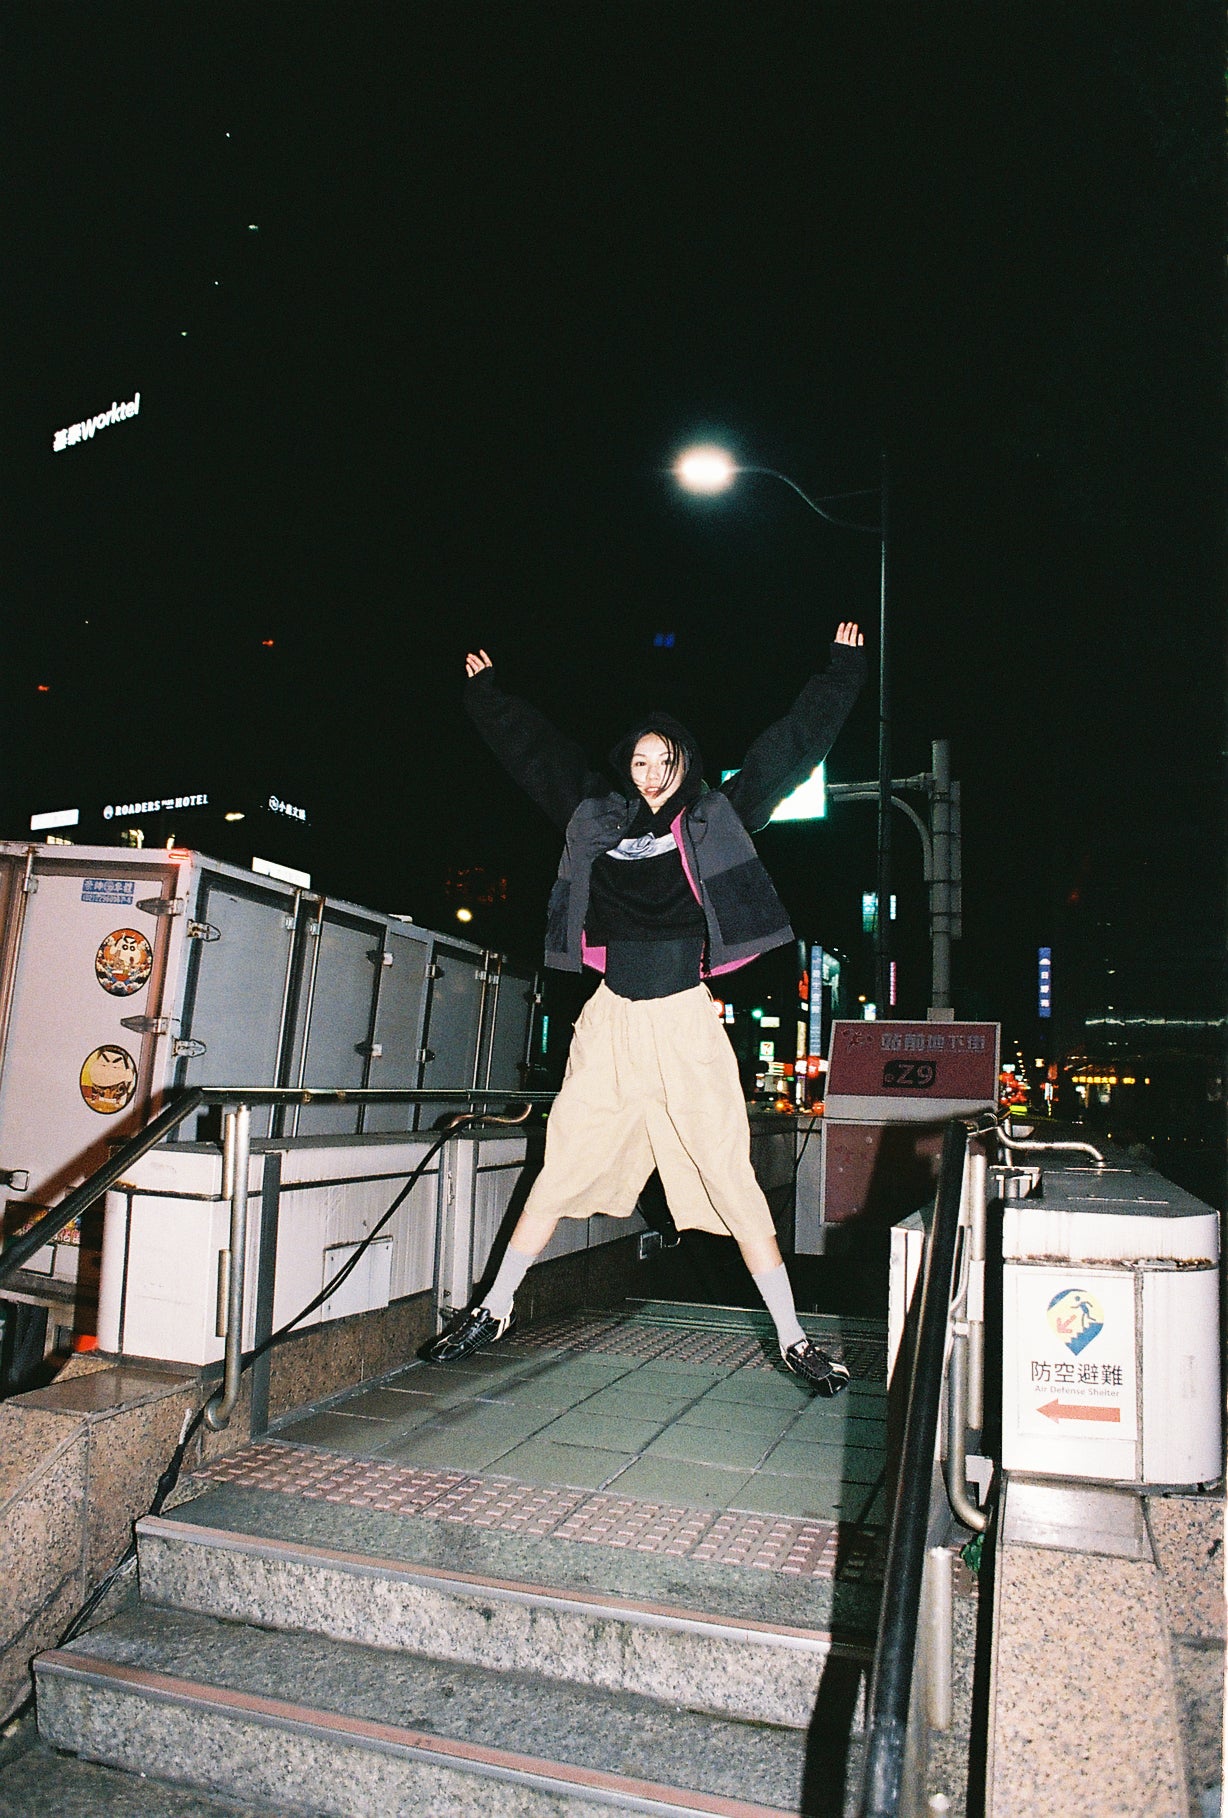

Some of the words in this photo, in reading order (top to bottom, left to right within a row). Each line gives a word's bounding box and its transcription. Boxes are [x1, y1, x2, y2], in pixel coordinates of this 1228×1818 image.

[114, 800, 161, 817] ROADERS
[175, 794, 209, 809] HOTEL
[881, 1033, 986, 1052] 站前地下街
[896, 1064, 934, 1086] Z9
[1031, 1360, 1124, 1386] 防空避難
[1035, 1385, 1048, 1393] Air
[1050, 1385, 1086, 1396] Defense
[1088, 1387, 1120, 1397] Shelter
